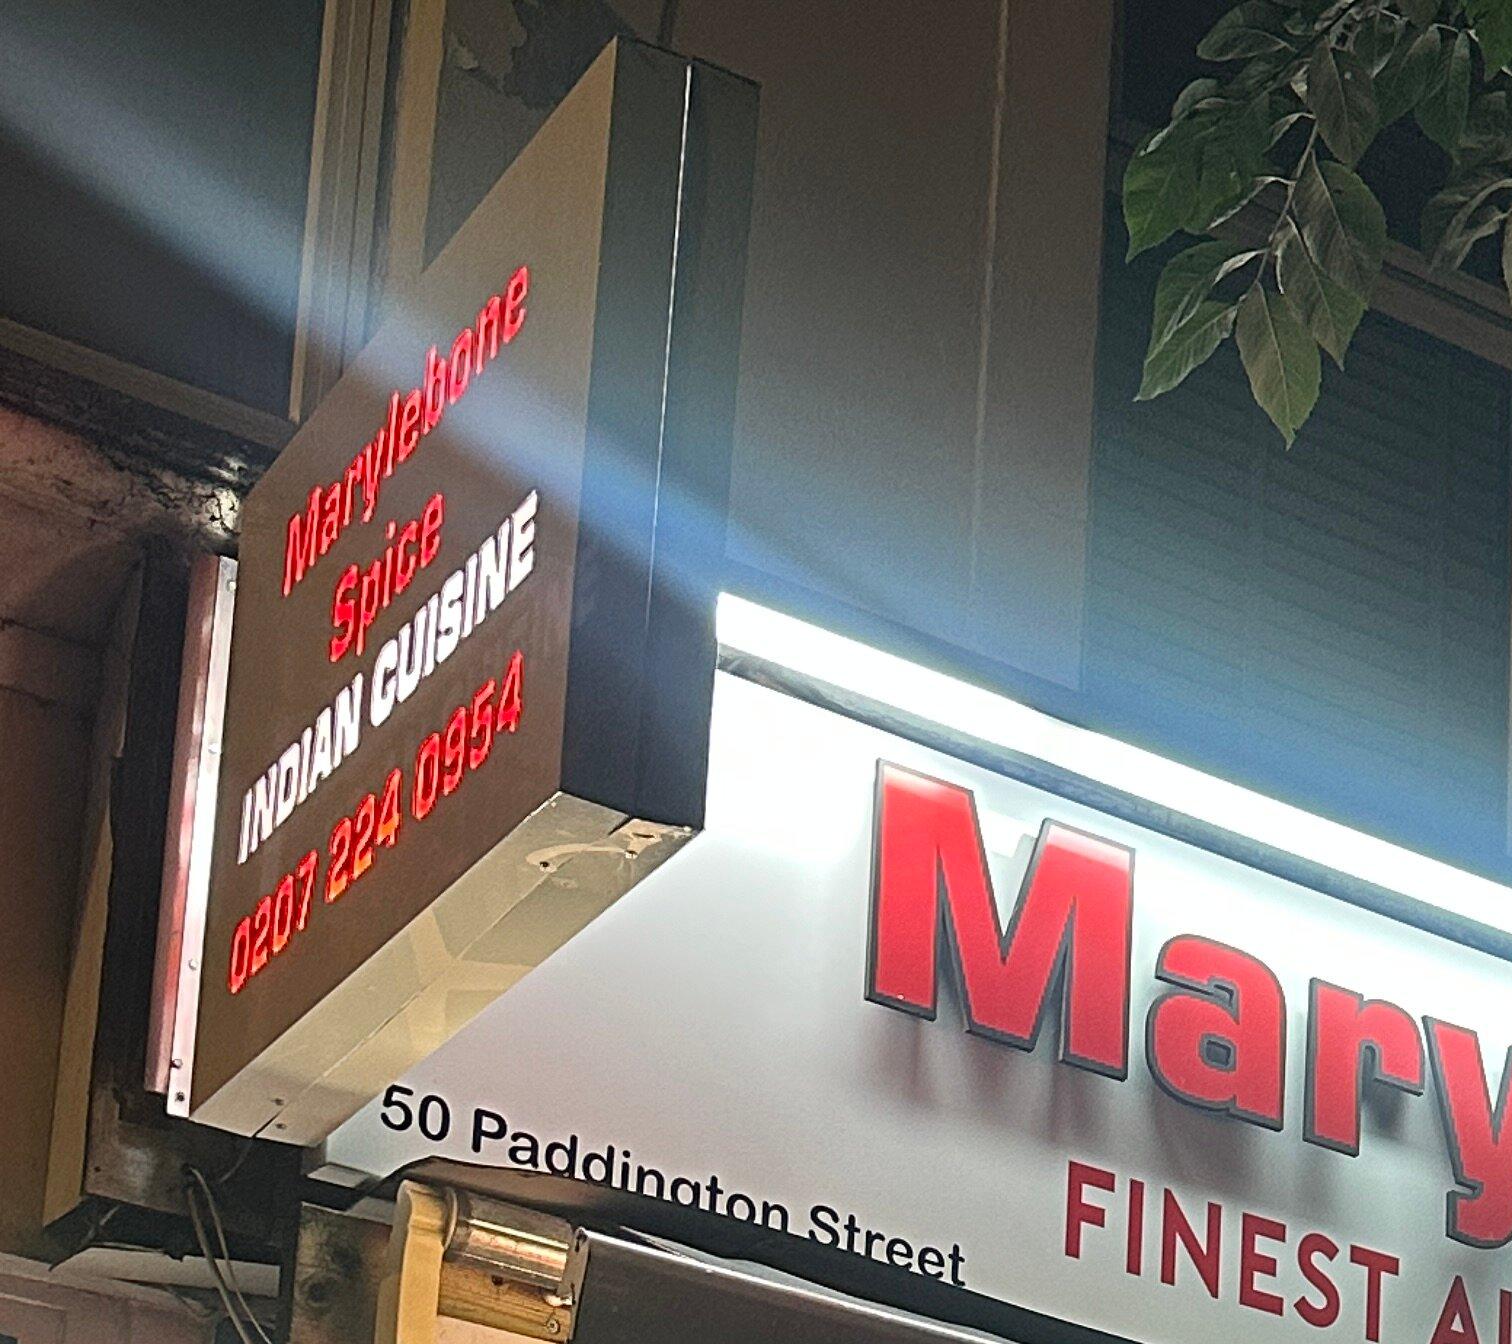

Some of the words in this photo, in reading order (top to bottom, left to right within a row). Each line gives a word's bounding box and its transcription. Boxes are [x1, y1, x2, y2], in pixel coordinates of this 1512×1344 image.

[282, 265, 529, 597] Marylebone
[236, 673, 361, 865] INDIAN
[370, 490, 539, 728] CUISINE
[330, 493, 445, 663] Spice
[227, 851, 320, 994] 0207
[324, 768, 402, 904] 224
[410, 651, 524, 821] 0954
[380, 1085, 451, 1141] 50
[472, 1108, 788, 1234] Paddington
[808, 1206, 966, 1287] Street
[1064, 1161, 1400, 1344] FINEST
